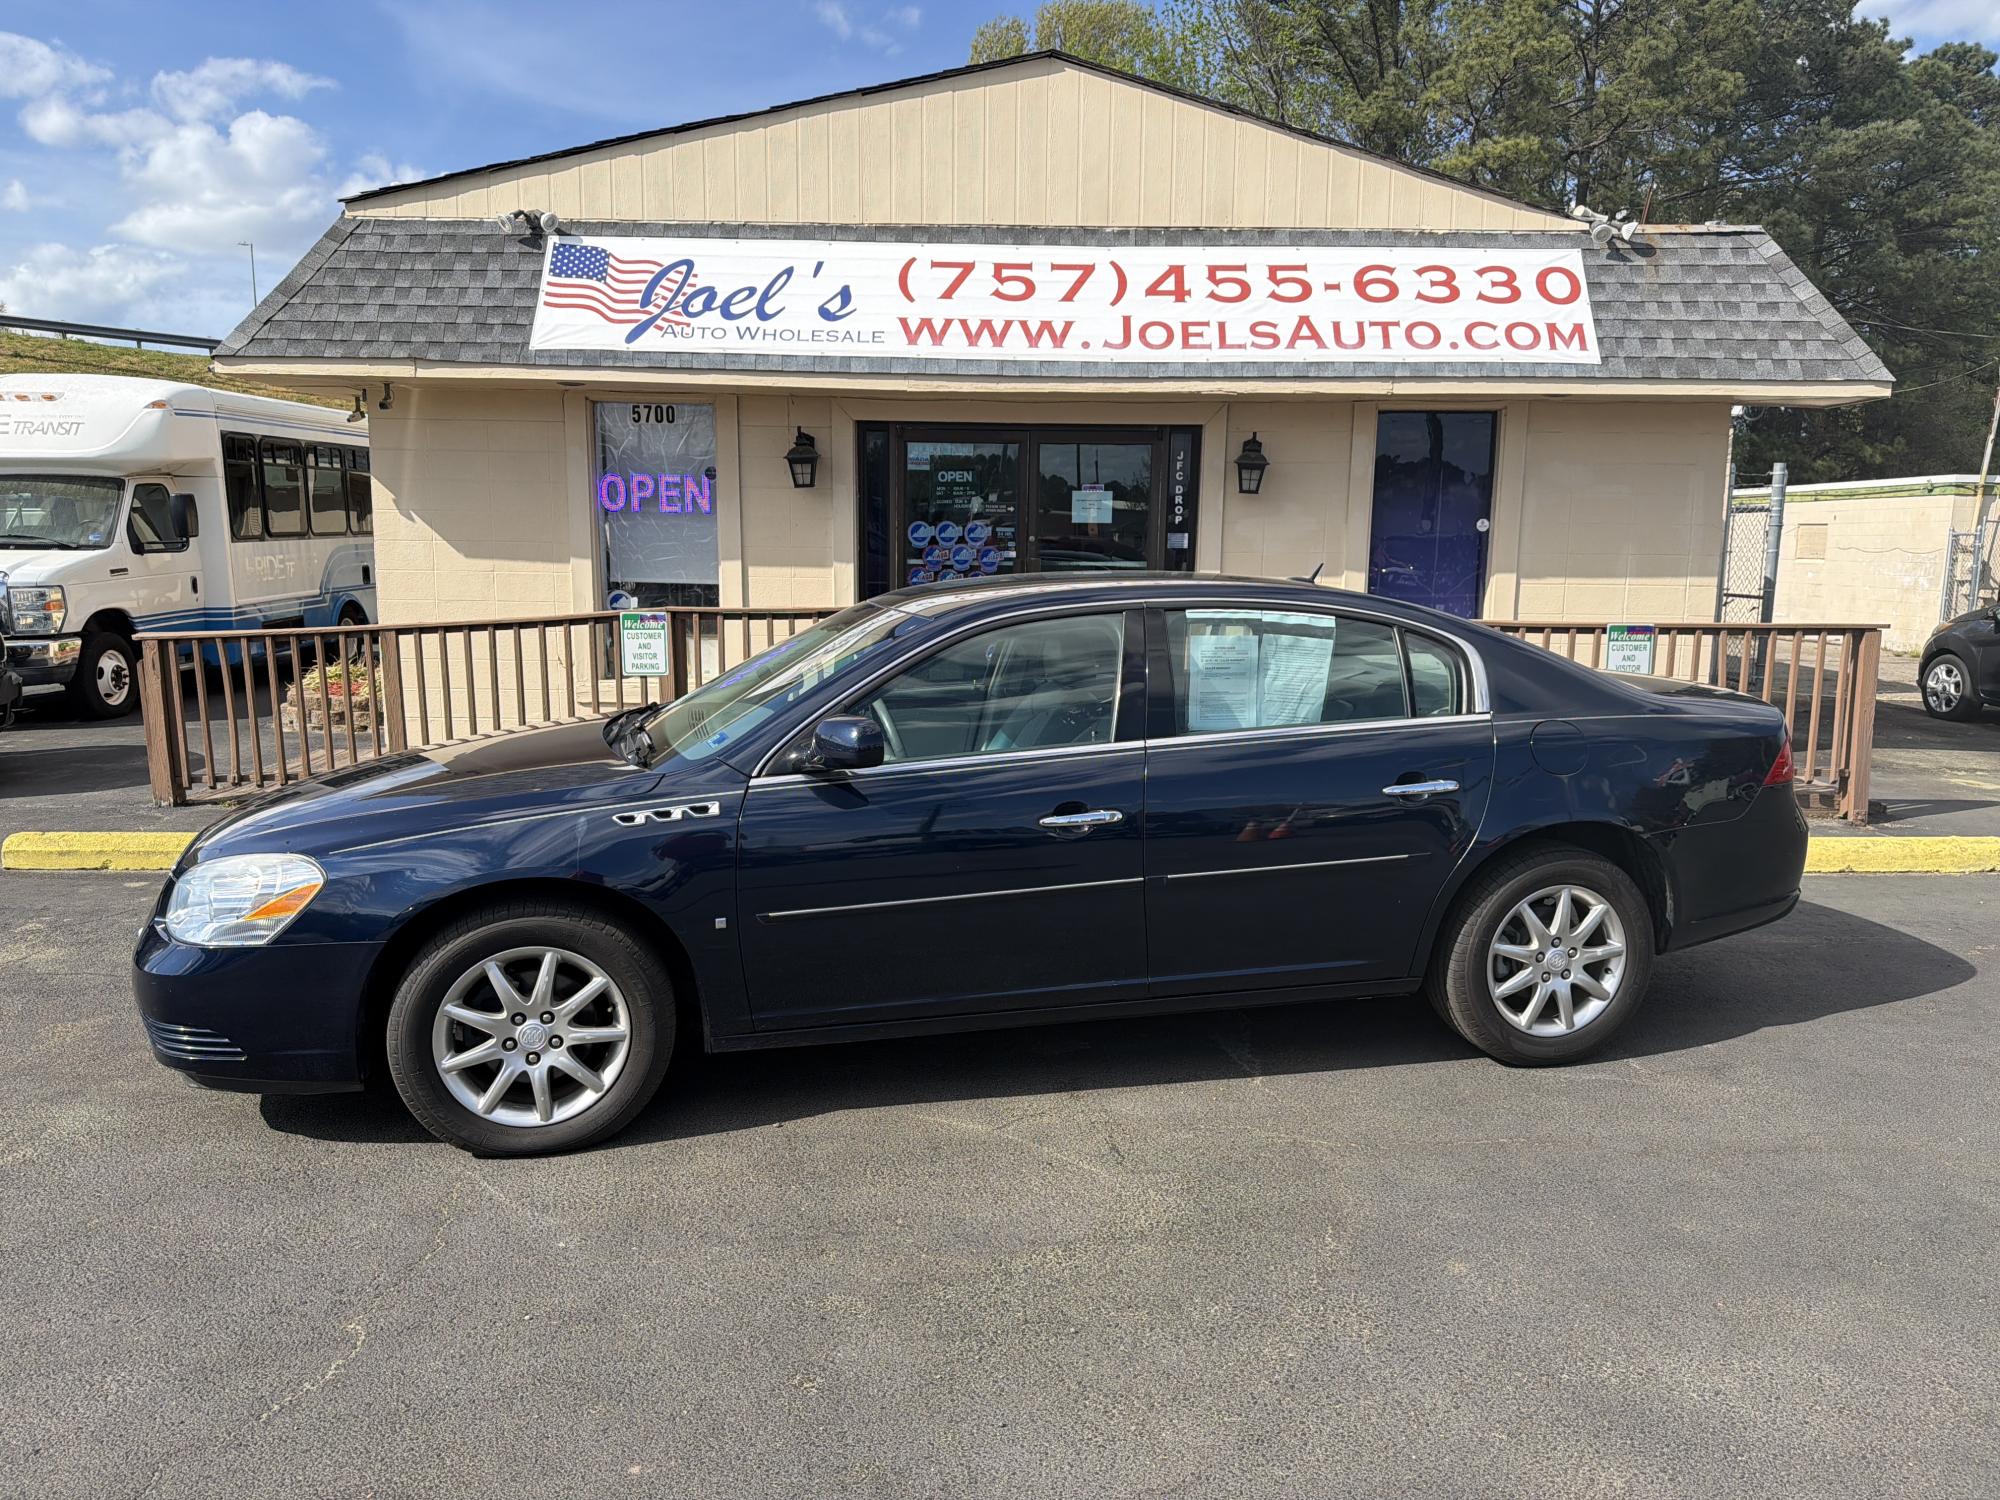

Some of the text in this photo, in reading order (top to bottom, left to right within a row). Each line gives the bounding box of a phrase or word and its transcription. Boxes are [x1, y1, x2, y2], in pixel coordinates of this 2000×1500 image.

[898, 257, 1582, 306] (757)455-6330
[625, 258, 858, 345] Joel's
[631, 404, 676, 424] 5700
[14, 420, 85, 435] TRANSIT
[938, 471, 972, 482] OPEN
[599, 473, 711, 515] OPEN
[623, 619, 664, 629] Welcome
[626, 632, 662, 640] CUSTOMER
[1610, 631, 1649, 641] Welcome
[638, 642, 651, 650] AND
[1611, 644, 1648, 652] CUSTOMER
[632, 652, 658, 660] VISITOR
[1621, 654, 1636, 662] AND
[631, 662, 660, 671] PARKING
[1616, 664, 1641, 673] VISITOR
